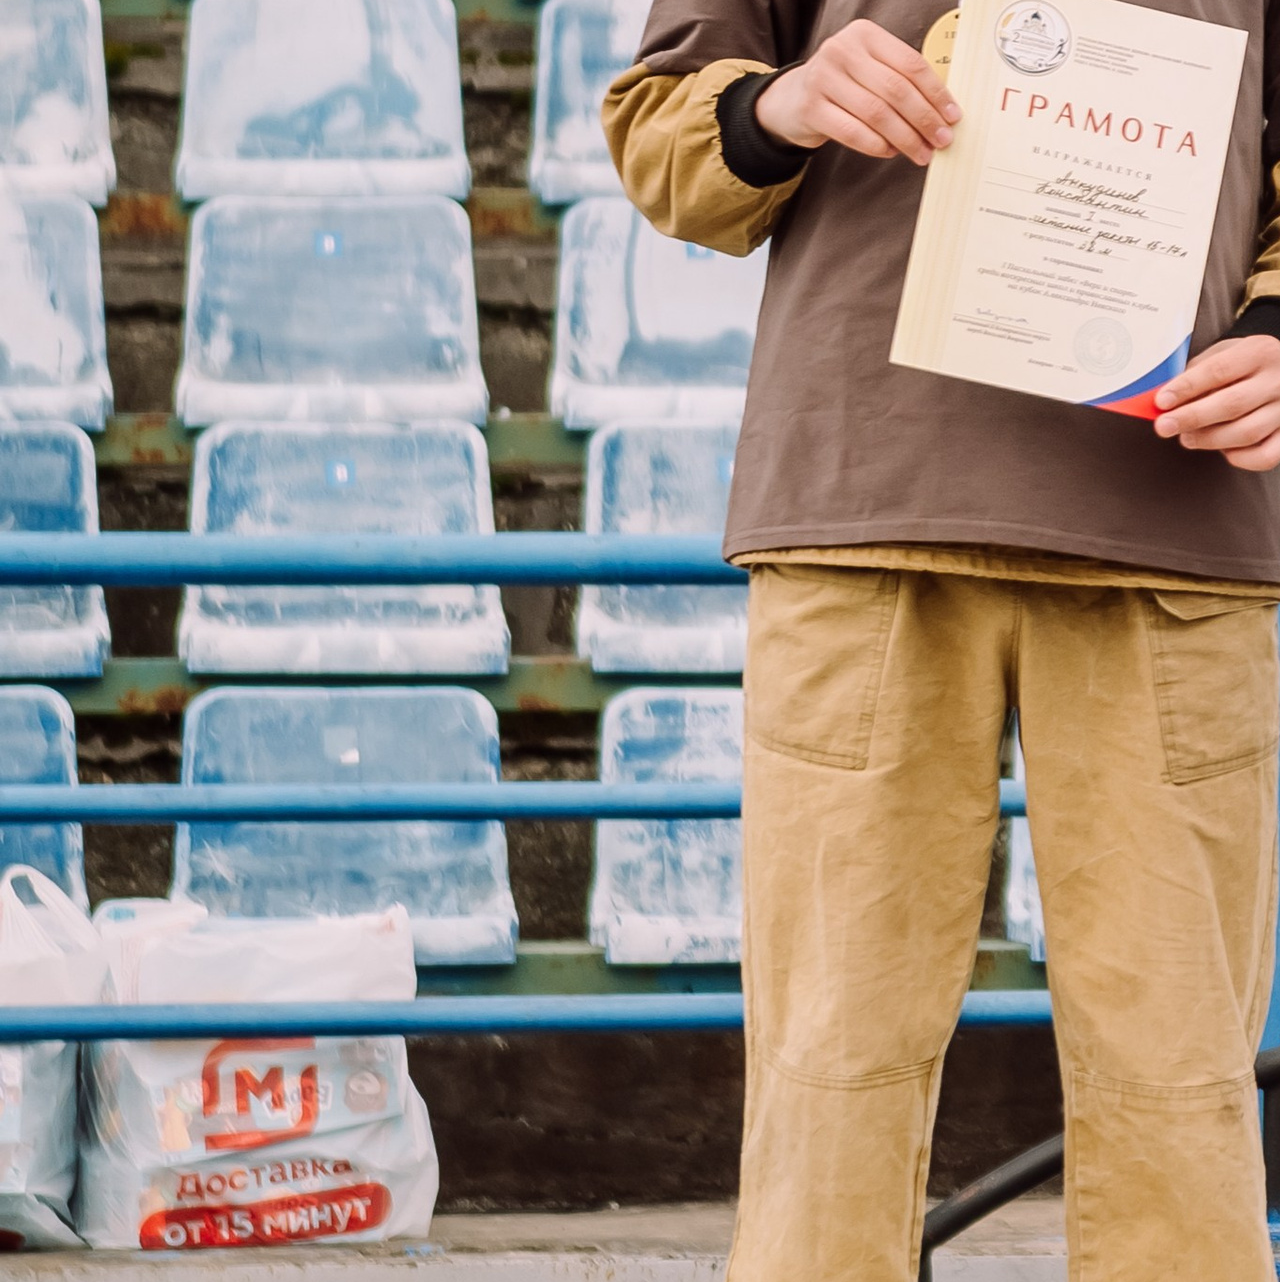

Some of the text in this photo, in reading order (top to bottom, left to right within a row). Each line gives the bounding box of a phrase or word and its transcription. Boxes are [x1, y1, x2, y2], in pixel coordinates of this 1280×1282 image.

[1000, 87, 1197, 157] ГРАМОТА
[1032, 145, 1153, 181] НАГРАЖДАЕТСЯ
[176, 1157, 354, 1201] Доставка
[164, 1197, 372, 1247] от 15 минут
